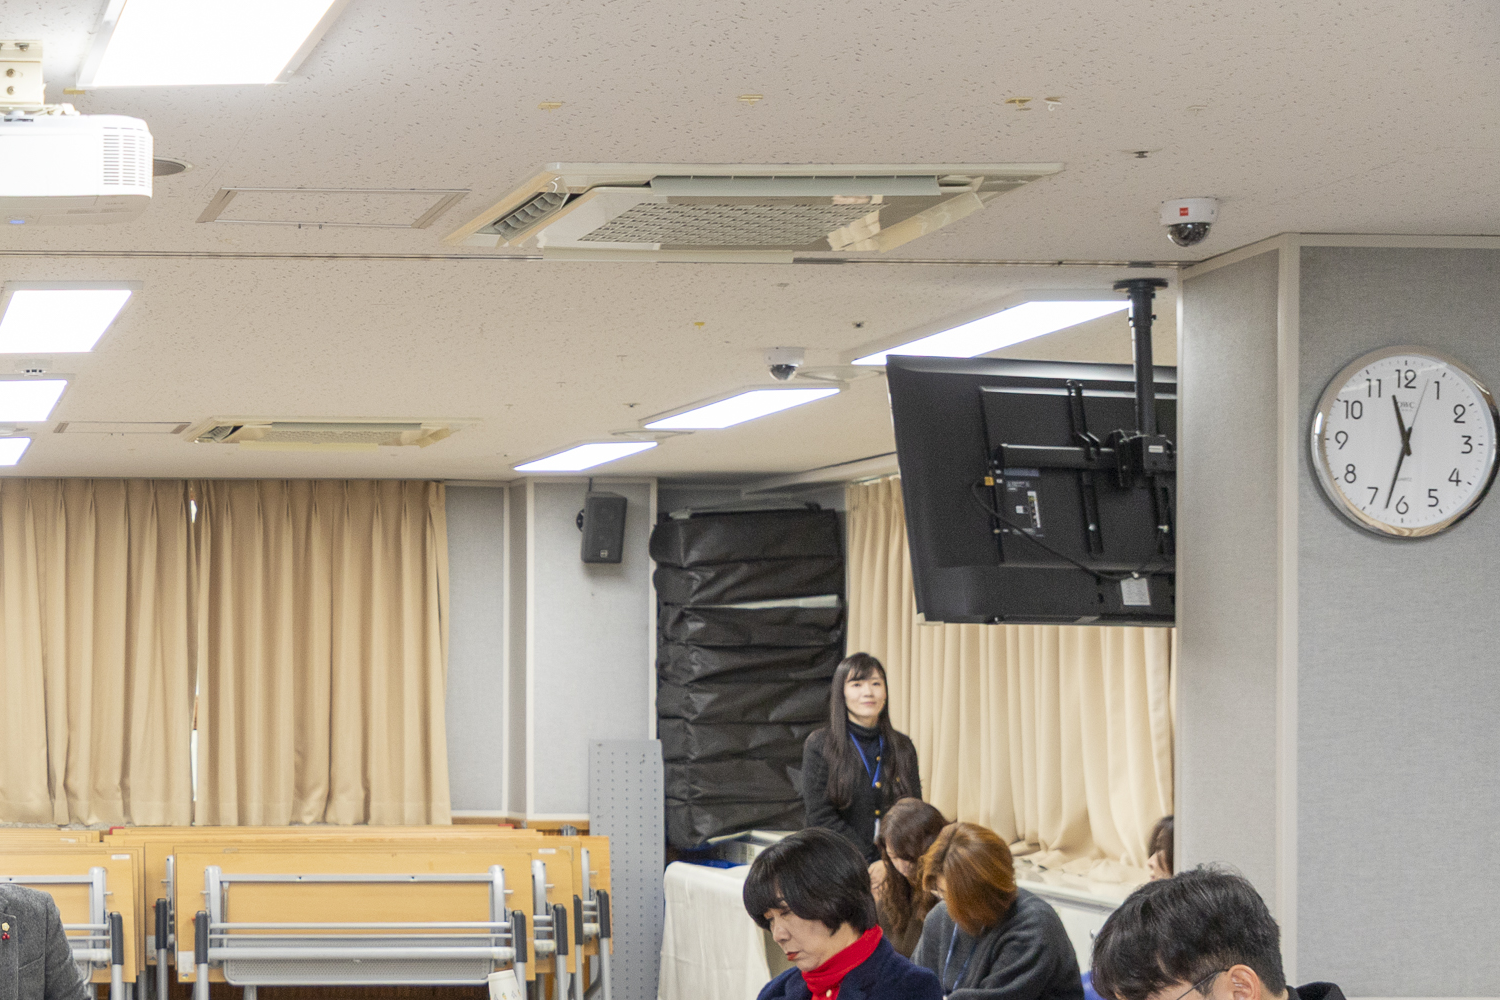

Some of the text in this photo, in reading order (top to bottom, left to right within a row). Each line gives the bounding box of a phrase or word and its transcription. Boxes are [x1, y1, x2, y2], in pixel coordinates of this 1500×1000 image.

[1366, 378, 1382, 398] 11
[1395, 369, 1417, 389] 12
[1434, 381, 1440, 400] 1
[1343, 400, 1363, 420] 10
[1453, 404, 1466, 423] 2
[1335, 430, 1348, 450] 9
[1461, 435, 1473, 454] 3
[1344, 464, 1357, 484] 8
[1448, 468, 1462, 486] 4
[1367, 487, 1379, 505] 7
[1395, 495, 1409, 515] 6
[1427, 488, 1439, 508] 5
